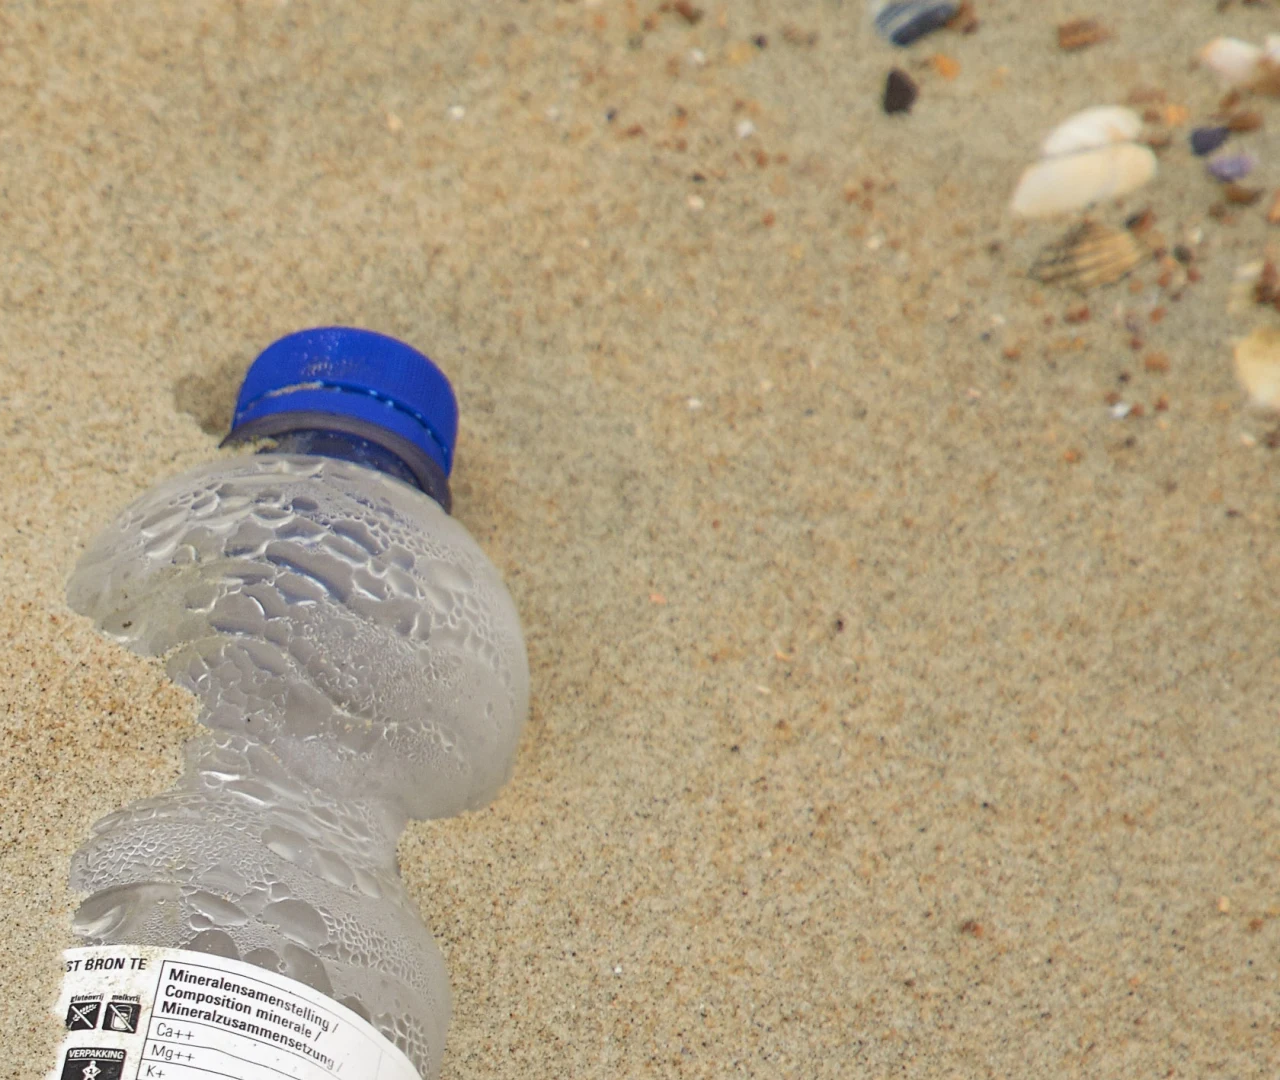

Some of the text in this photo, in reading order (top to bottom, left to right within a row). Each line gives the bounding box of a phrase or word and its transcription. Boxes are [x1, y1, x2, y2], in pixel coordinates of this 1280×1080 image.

[84, 958, 125, 971] BRON
[130, 957, 148, 970] TE
[168, 968, 330, 1032] Mineralensamenstelling
[165, 984, 252, 1015] Composition
[255, 1007, 313, 1037] minerale
[156, 1022, 195, 1040] Ca++
[161, 1000, 335, 1070] Mineralzusammensetzung
[68, 1049, 124, 1060] VERPAKKING
[151, 1044, 196, 1061] Mg++
[146, 1065, 166, 1079] K+
